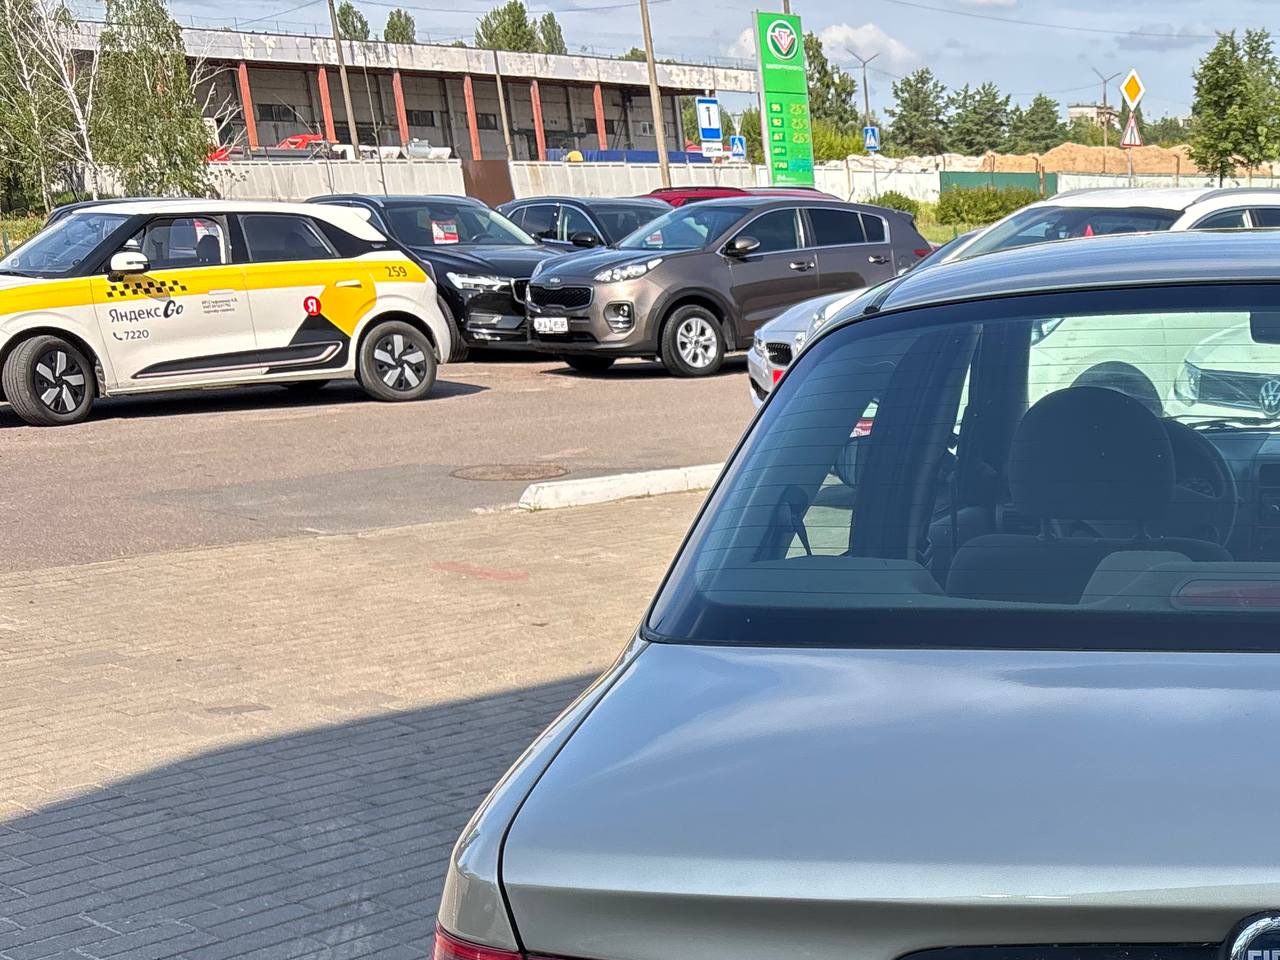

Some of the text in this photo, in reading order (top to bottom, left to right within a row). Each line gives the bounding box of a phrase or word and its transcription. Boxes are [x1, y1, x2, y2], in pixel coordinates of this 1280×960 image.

[385, 266, 408, 278] 259
[109, 307, 162, 323] Яндекс
[163, 300, 184, 318] Go
[124, 329, 149, 340] 7220
